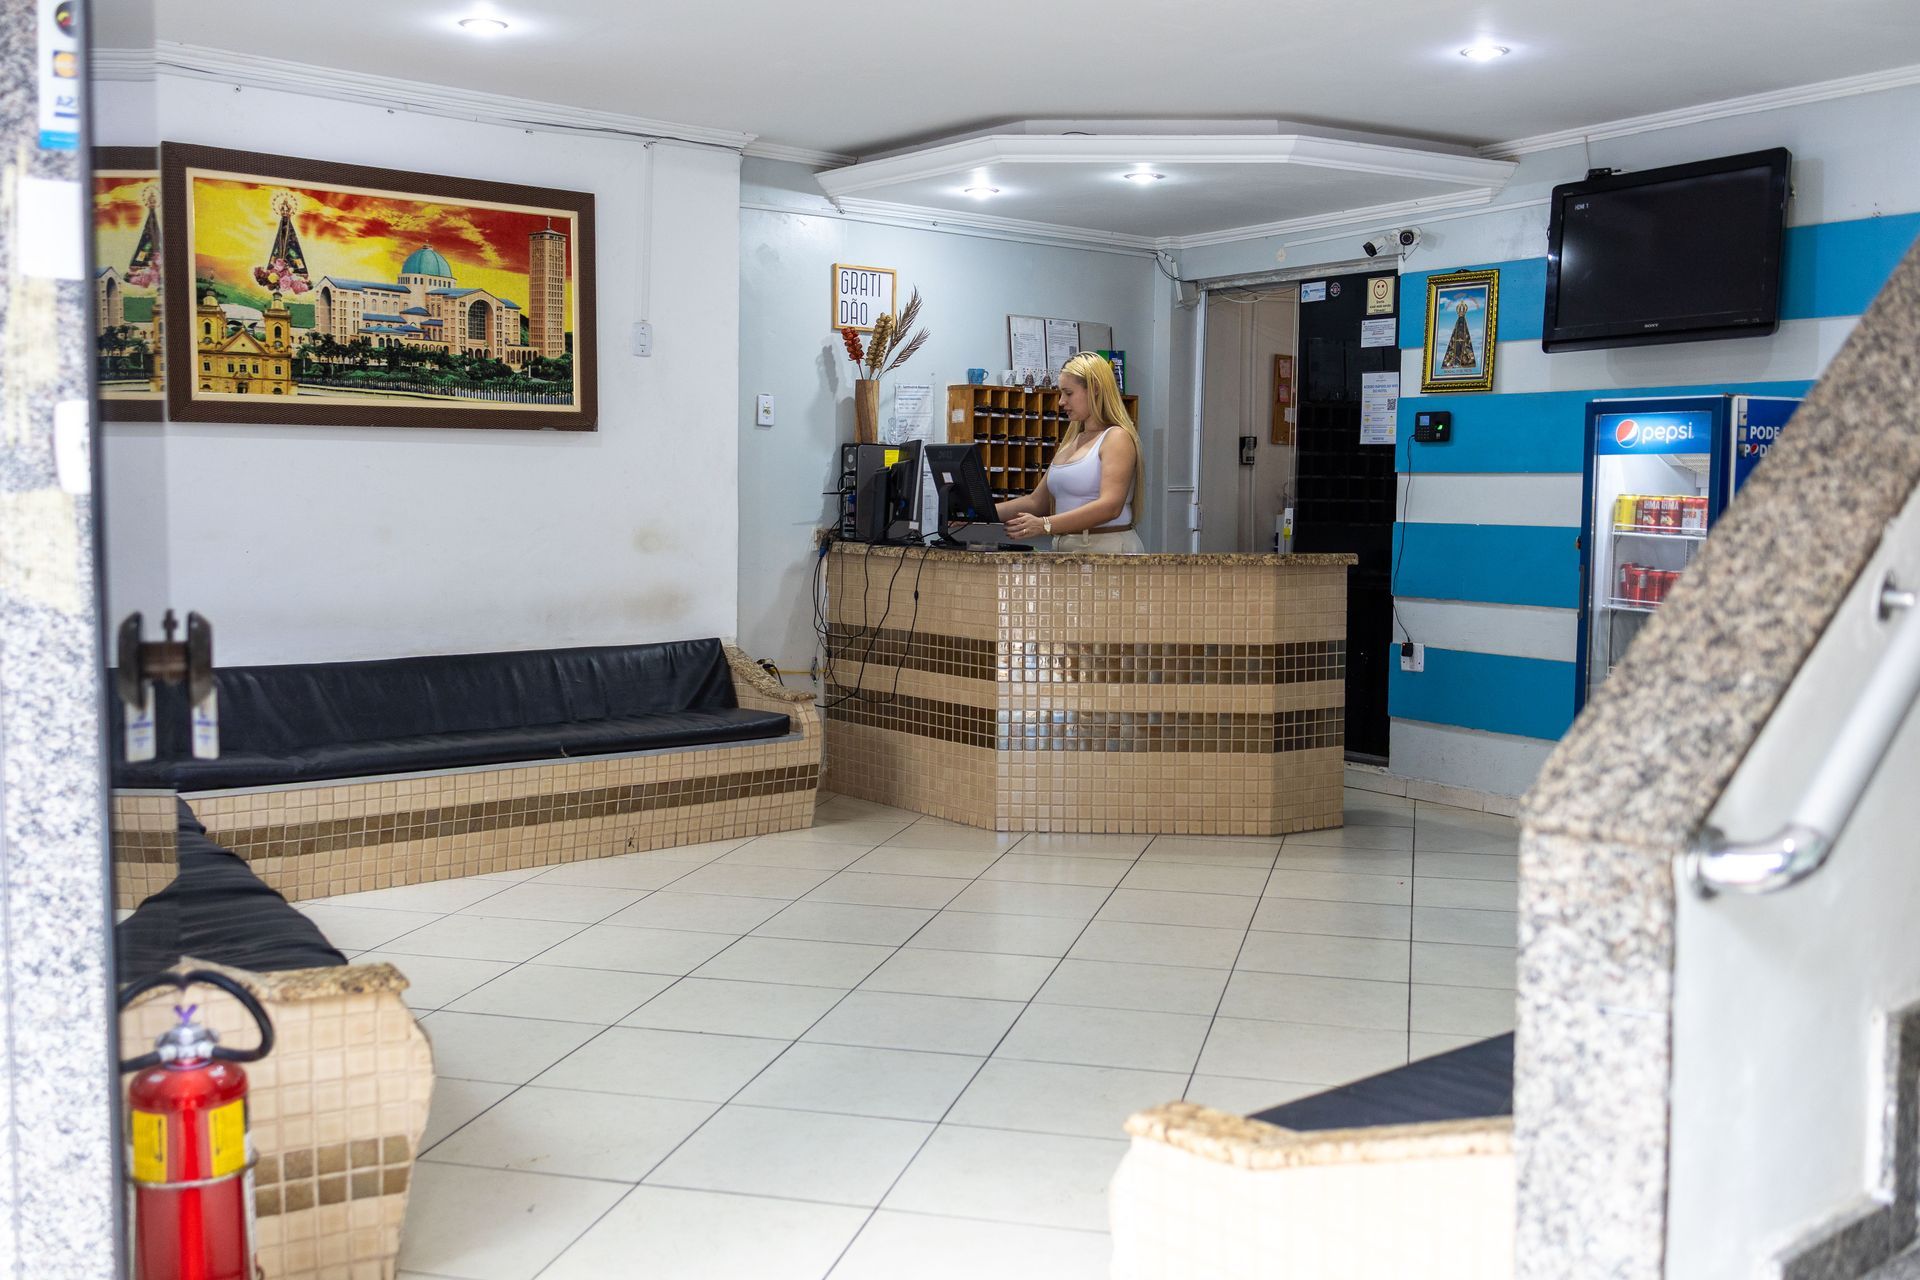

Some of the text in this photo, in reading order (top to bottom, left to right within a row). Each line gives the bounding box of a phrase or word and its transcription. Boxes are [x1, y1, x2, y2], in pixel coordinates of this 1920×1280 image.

[841, 270, 880, 297] GRATI
[841, 298, 867, 325] DÃO
[1642, 421, 1692, 444] pepsi
